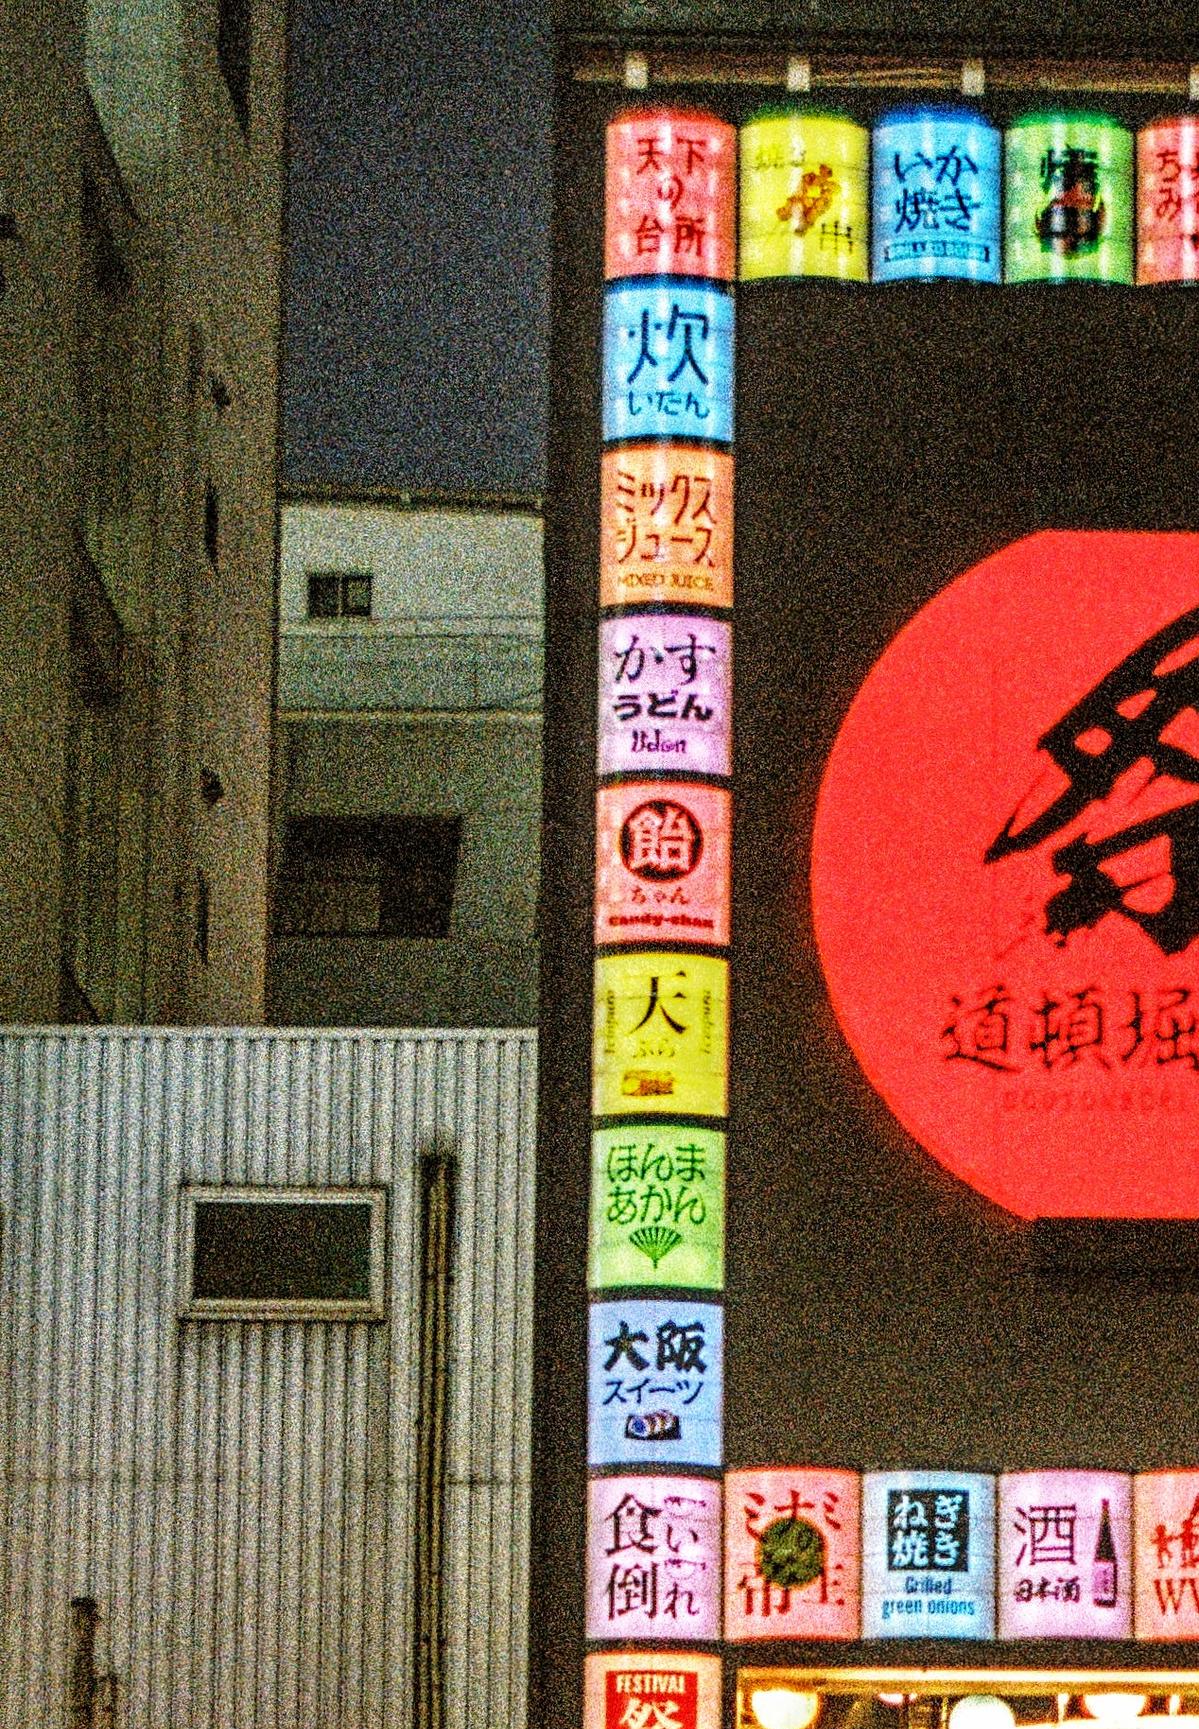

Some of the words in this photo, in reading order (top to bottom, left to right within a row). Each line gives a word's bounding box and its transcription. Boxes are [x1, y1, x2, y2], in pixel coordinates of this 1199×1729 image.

[636, 137, 707, 175] 天下
[894, 144, 978, 184] いか
[895, 189, 981, 233] 焼き
[636, 217, 706, 256] 台所
[627, 304, 709, 385] 炊
[629, 392, 709, 419] いたん
[616, 471, 718, 524] ミックス
[616, 517, 716, 567] ジュース
[615, 634, 716, 684] かす
[613, 688, 713, 721] うどん
[607, 1143, 706, 1183] ほんま
[607, 1185, 707, 1225] あかん
[603, 1320, 707, 1374] 大阪
[602, 1378, 704, 1406] スイーツ
[893, 1496, 963, 1527] ねぎ
[893, 1532, 960, 1568] 焼き
[1014, 1504, 1077, 1567] 酒
[905, 1577, 953, 1595] Grilled
[1014, 1577, 1081, 1603] 日本酒
[882, 1600, 922, 1619] green
[927, 1600, 975, 1616] onions
[615, 1675, 686, 1694] FESTIVAL
